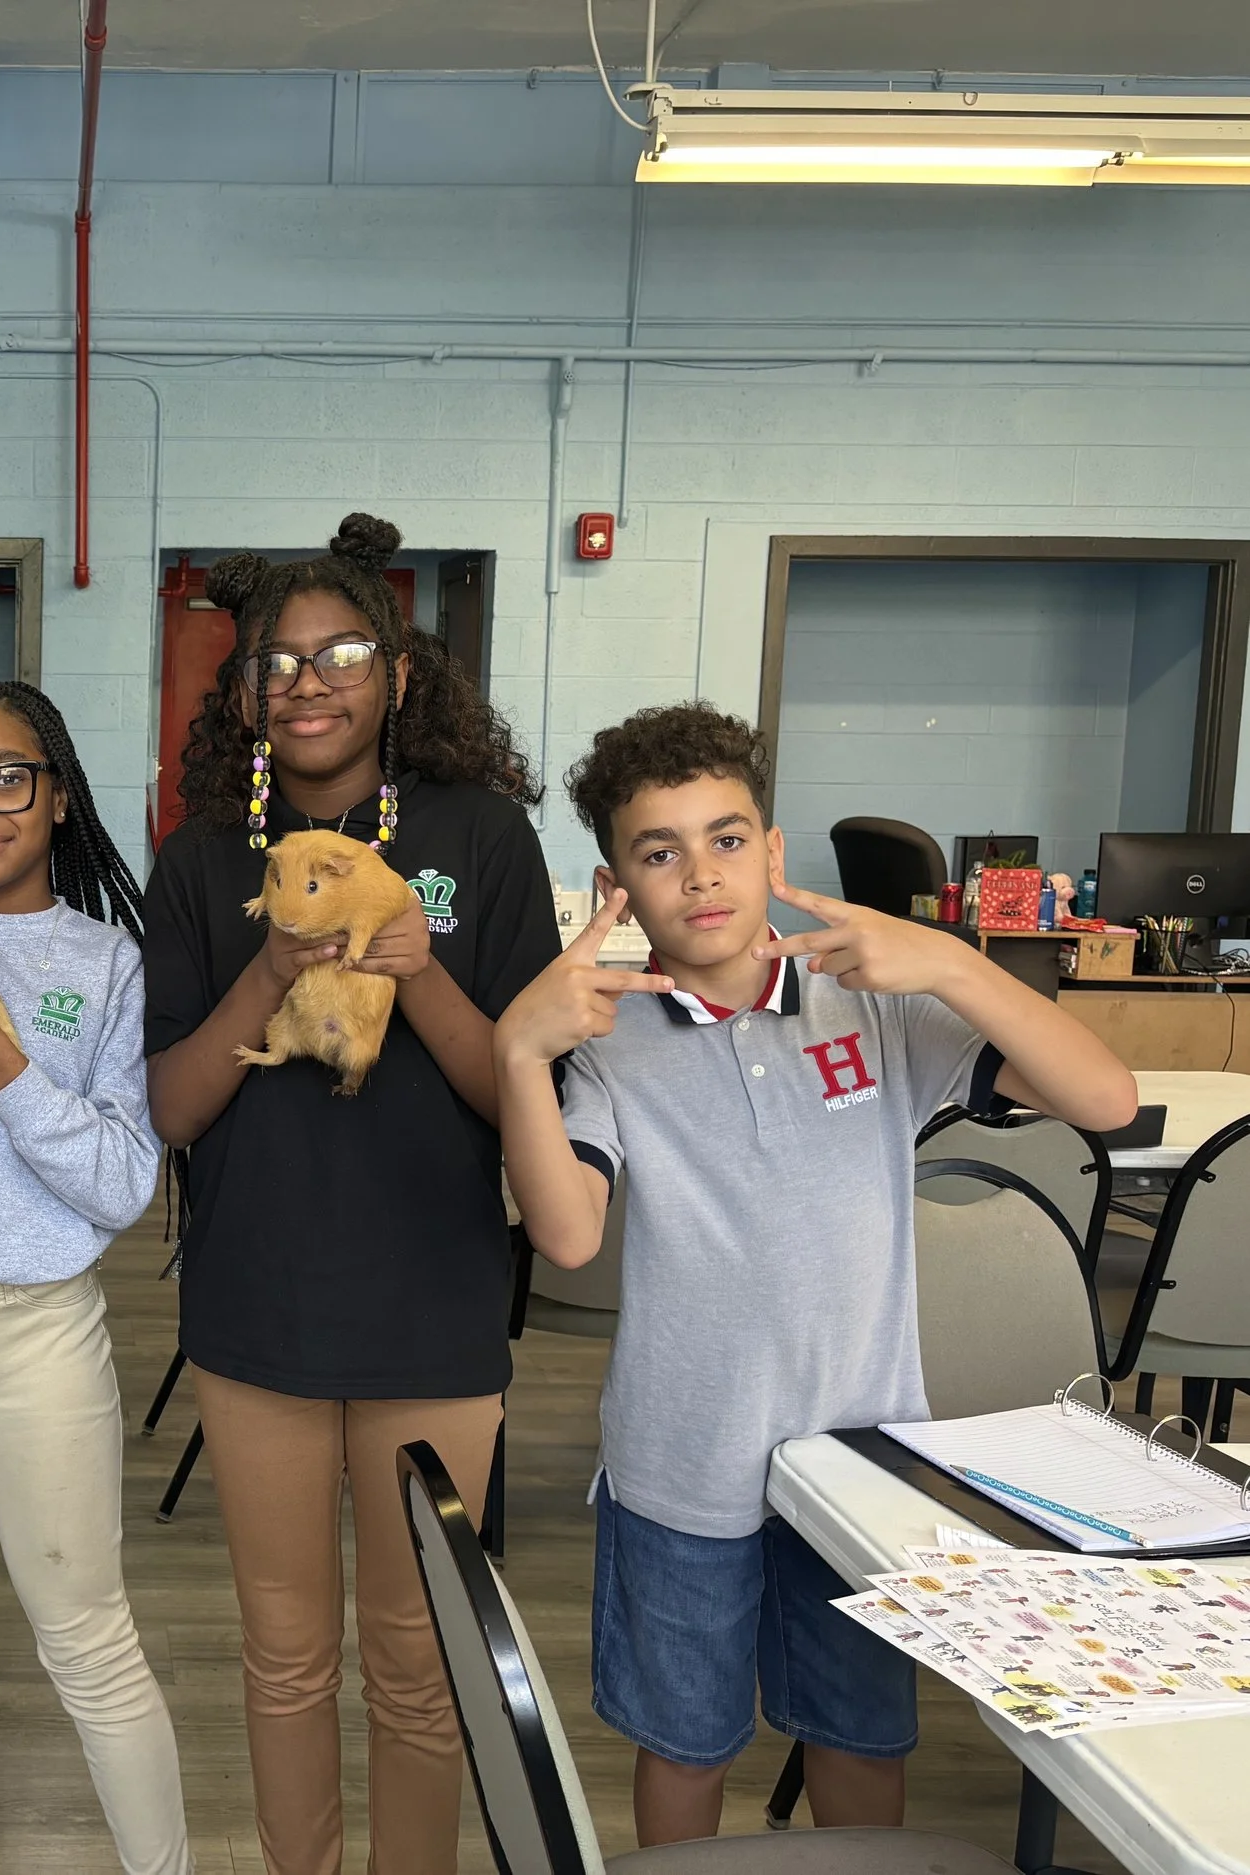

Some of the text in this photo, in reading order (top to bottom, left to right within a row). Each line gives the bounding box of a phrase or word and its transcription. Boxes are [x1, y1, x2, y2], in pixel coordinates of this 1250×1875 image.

[31, 1016, 81, 1038] EMERALD
[35, 1026, 75, 1042] ACADEMY
[803, 1032, 876, 1100] H
[825, 1086, 878, 1112] HILFIGER
